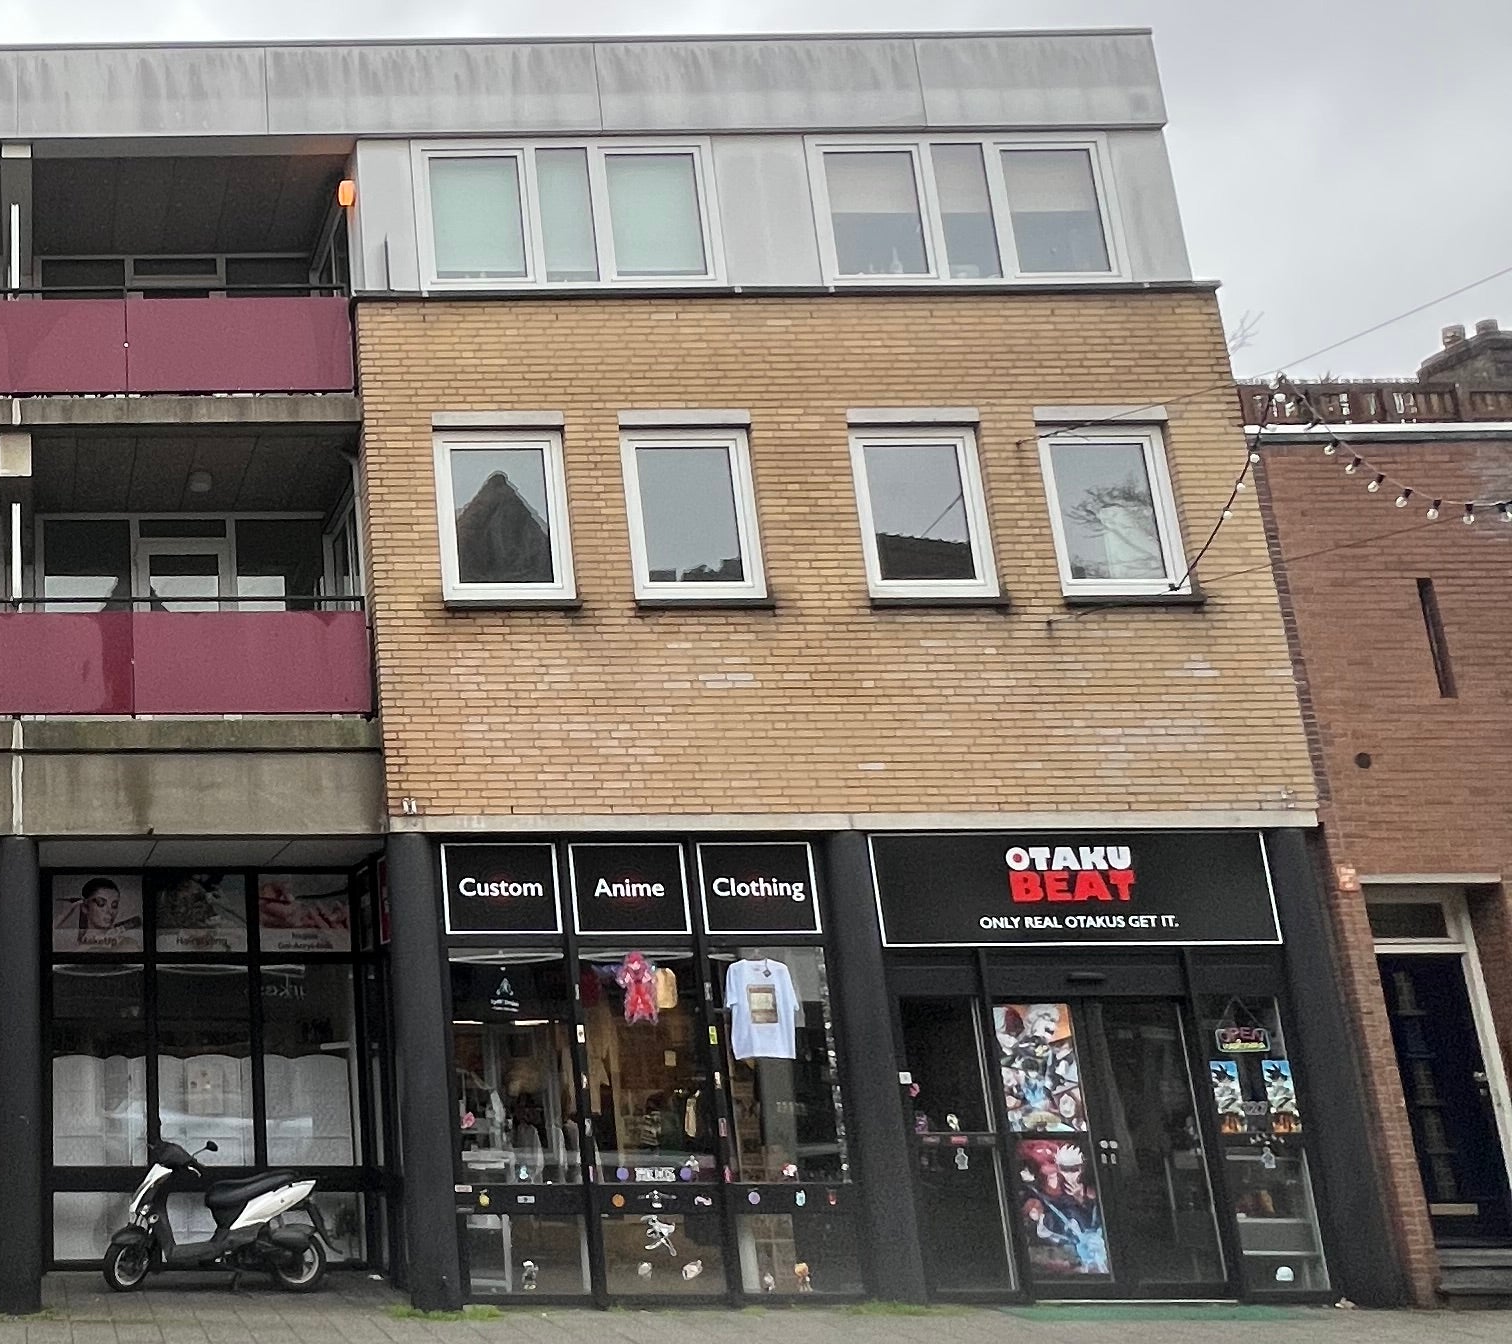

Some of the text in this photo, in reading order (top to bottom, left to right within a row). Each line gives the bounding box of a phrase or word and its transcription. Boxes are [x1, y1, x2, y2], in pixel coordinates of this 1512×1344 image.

[1005, 846, 1132, 871] OTAKU
[458, 877, 544, 897] Custom
[594, 878, 665, 897] Anime
[712, 877, 806, 901] Clothing
[1009, 870, 1137, 903] BEAT
[979, 915, 1180, 929] ONLY REAL OTAKUS GET IT.
